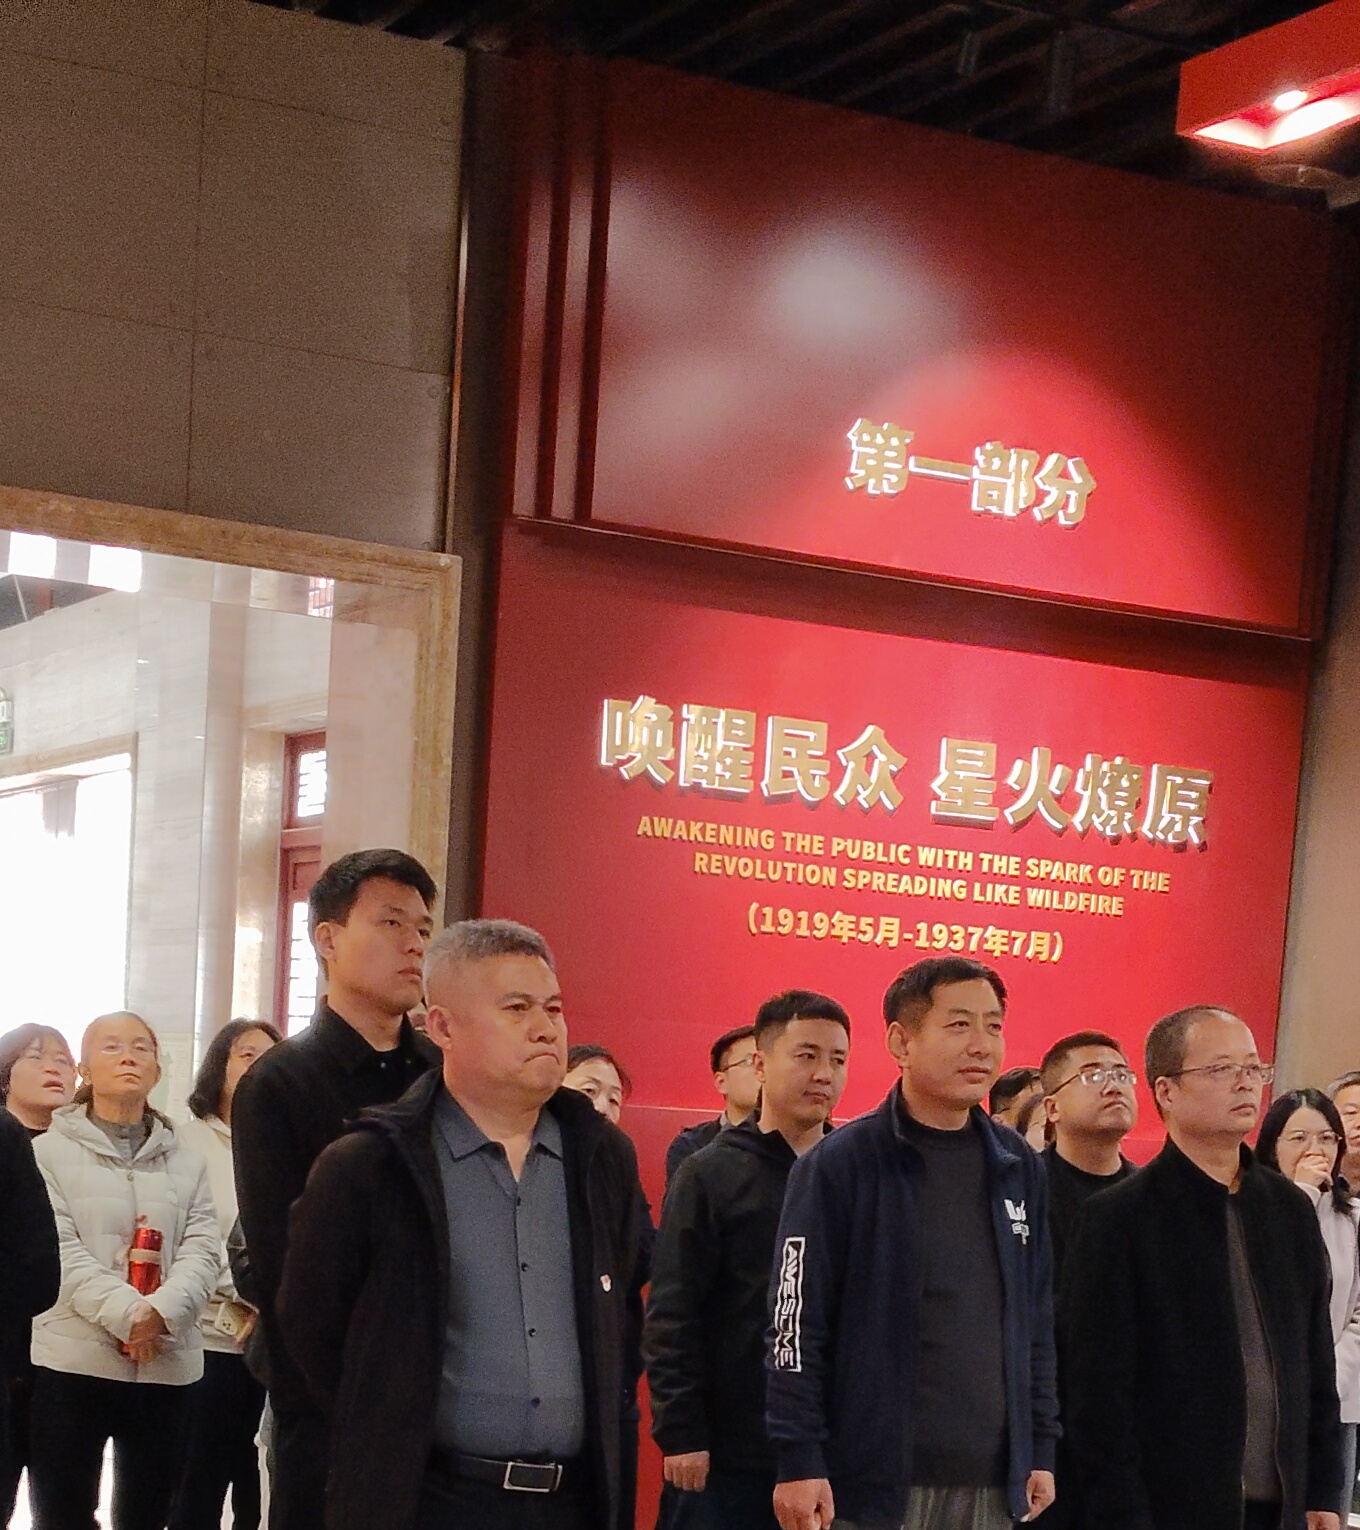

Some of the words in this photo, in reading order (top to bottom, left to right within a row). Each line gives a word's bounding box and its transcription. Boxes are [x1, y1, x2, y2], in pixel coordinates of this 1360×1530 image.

[844, 418, 1097, 526] 第一部分
[600, 695, 907, 812] 唤醒民众
[931, 738, 1215, 847] 星火燎原
[637, 816, 775, 850] AWAKENING
[782, 832, 826, 856] THE
[832, 837, 911, 864] PUBLIC
[917, 846, 973, 871] WITH
[979, 853, 1021, 876] THE
[1026, 858, 1094, 885] SPARK
[1098, 866, 1126, 887] OF
[1130, 869, 1172, 893] THE
[694, 852, 837, 887] REVOLUTION
[843, 868, 968, 900] SPREADING
[973, 882, 1021, 905] LIKE
[1026, 887, 1124, 917] WILDFIRE
[748, 902, 1064, 962] (1919年5月-1937年7月)
